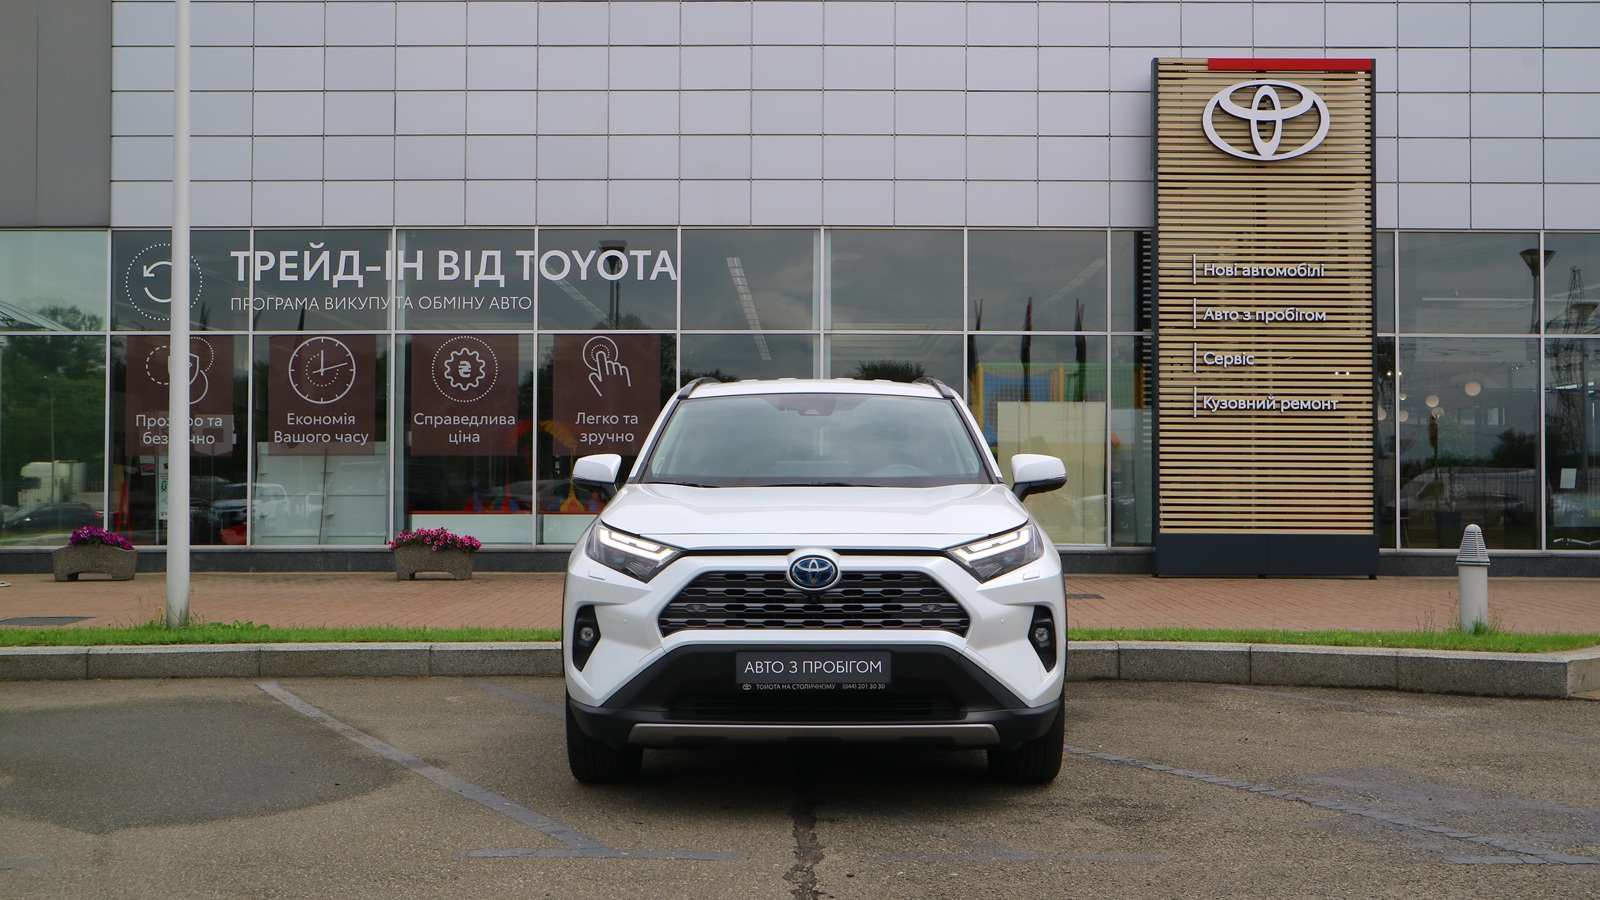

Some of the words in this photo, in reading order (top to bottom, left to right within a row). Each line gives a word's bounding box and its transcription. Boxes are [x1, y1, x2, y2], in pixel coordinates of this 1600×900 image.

[230, 242, 423, 288] ТРЕЙД-ІН
[438, 250, 505, 288] ВІД
[515, 249, 677, 281] TOYOTA
[1203, 263, 1238, 277] Нові
[1242, 263, 1325, 277] автомобілі
[231, 297, 320, 311] ПРОГРАМА
[325, 296, 391, 310] ВИКУПУ
[395, 296, 414, 309] ТА
[418, 296, 485, 310] ОБМІНУ
[489, 296, 532, 310] АВТО
[1203, 307, 1239, 321] Авто
[1242, 311, 1251, 321] з
[1255, 307, 1327, 324] пробігом
[1203, 352, 1255, 368] Сервіс
[1203, 395, 1276, 413] Кузовний
[1280, 399, 1339, 413] ремонт
[207, 417, 223, 427] та
[287, 412, 356, 425] Економія
[413, 412, 516, 428] Справедлива
[575, 412, 619, 425] Легко
[623, 415, 639, 425] та
[142, 431, 215, 445] безчно
[274, 431, 331, 443] Вашого
[335, 433, 369, 446] часу
[448, 430, 480, 445] ціна
[580, 432, 635, 446] зручно
[744, 661, 785, 674] АВТО
[802, 660, 882, 674] ПРОБІГОМ
